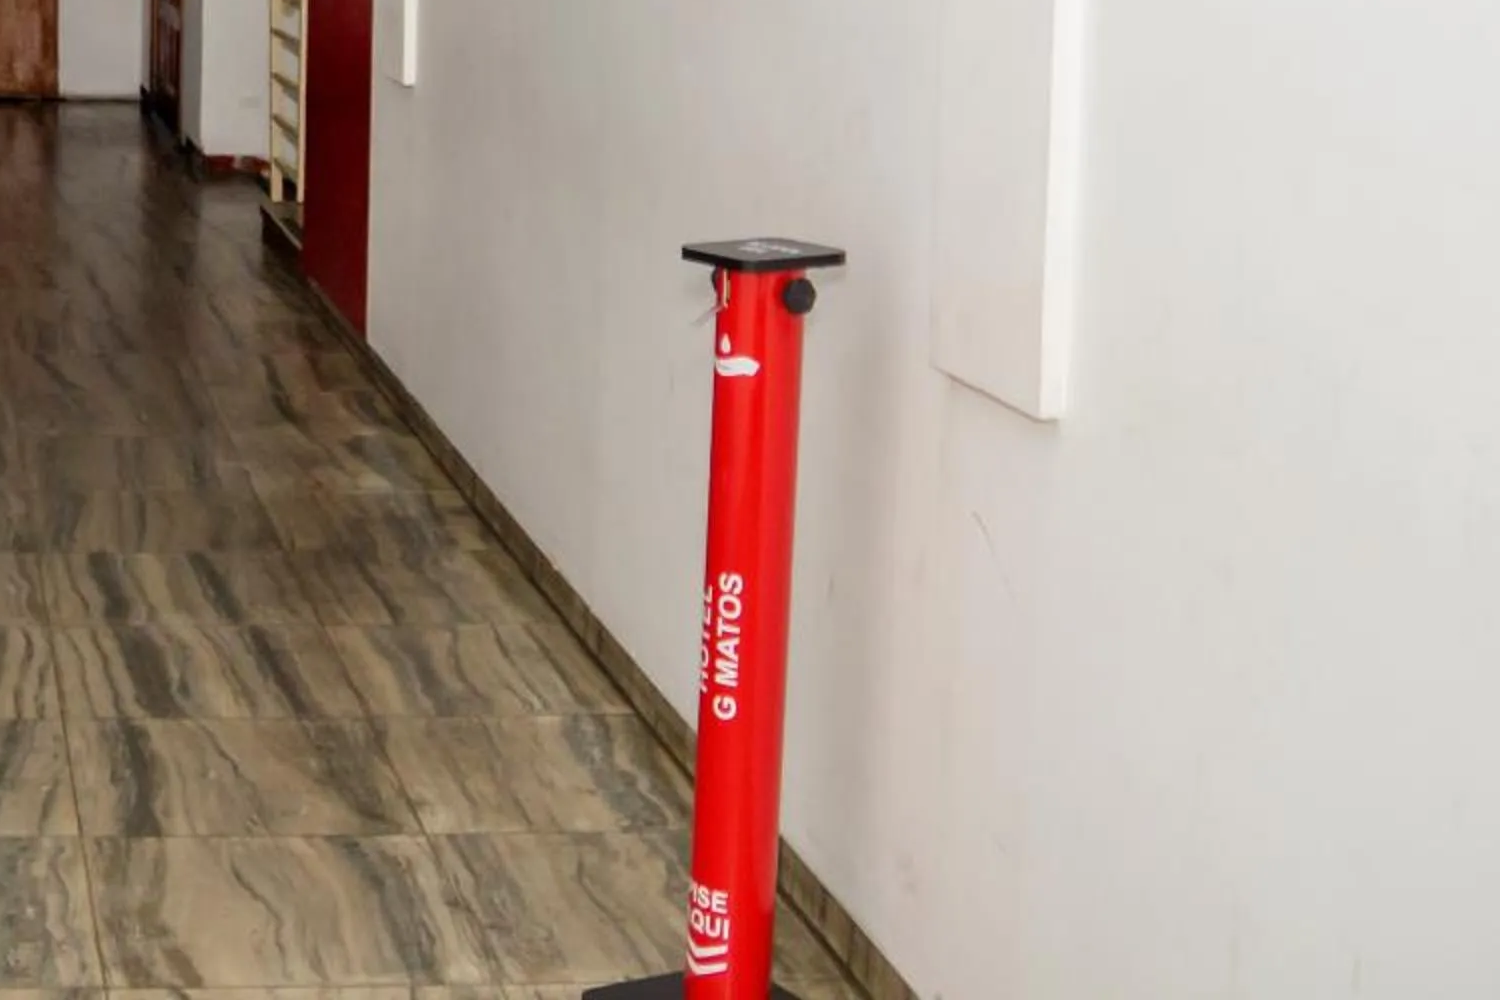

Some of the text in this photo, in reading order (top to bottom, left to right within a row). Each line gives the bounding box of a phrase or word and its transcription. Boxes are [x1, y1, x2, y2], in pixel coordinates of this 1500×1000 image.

[712, 572, 744, 721] G MATOS
[691, 907, 730, 940] QUI
